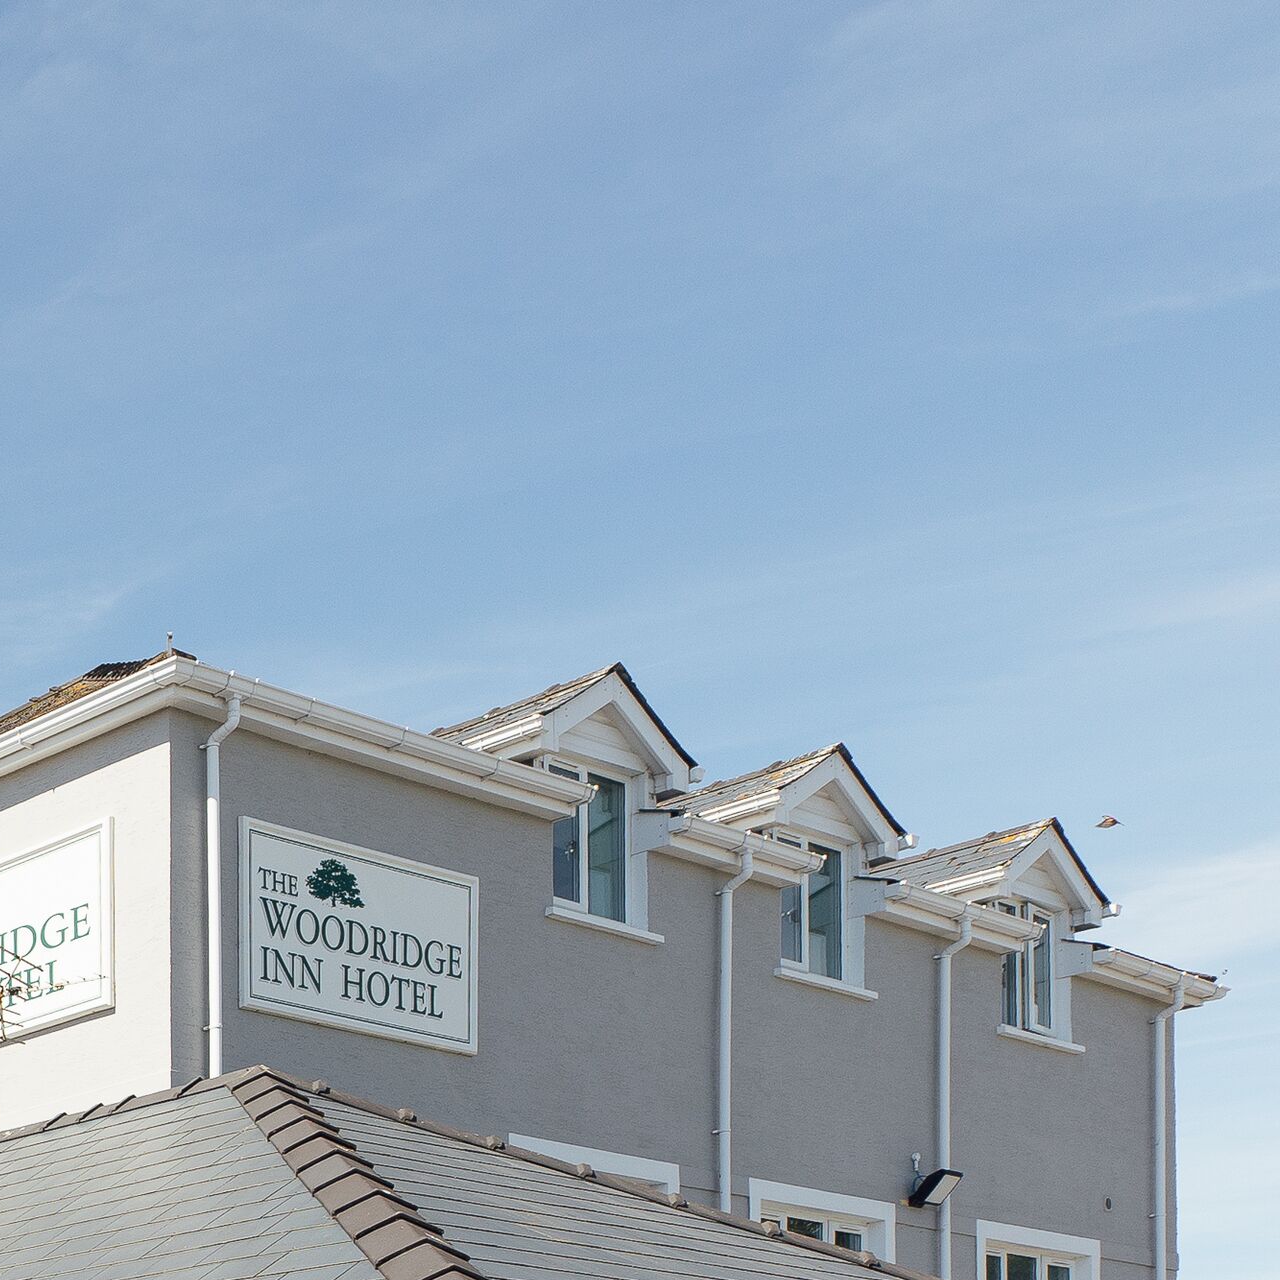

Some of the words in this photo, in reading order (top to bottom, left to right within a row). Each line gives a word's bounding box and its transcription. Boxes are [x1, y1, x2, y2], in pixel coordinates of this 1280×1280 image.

[258, 866, 298, 897] THE
[260, 896, 462, 979] WOODRIDGE
[260, 946, 324, 994] INN
[341, 964, 443, 1019] HOTEL
